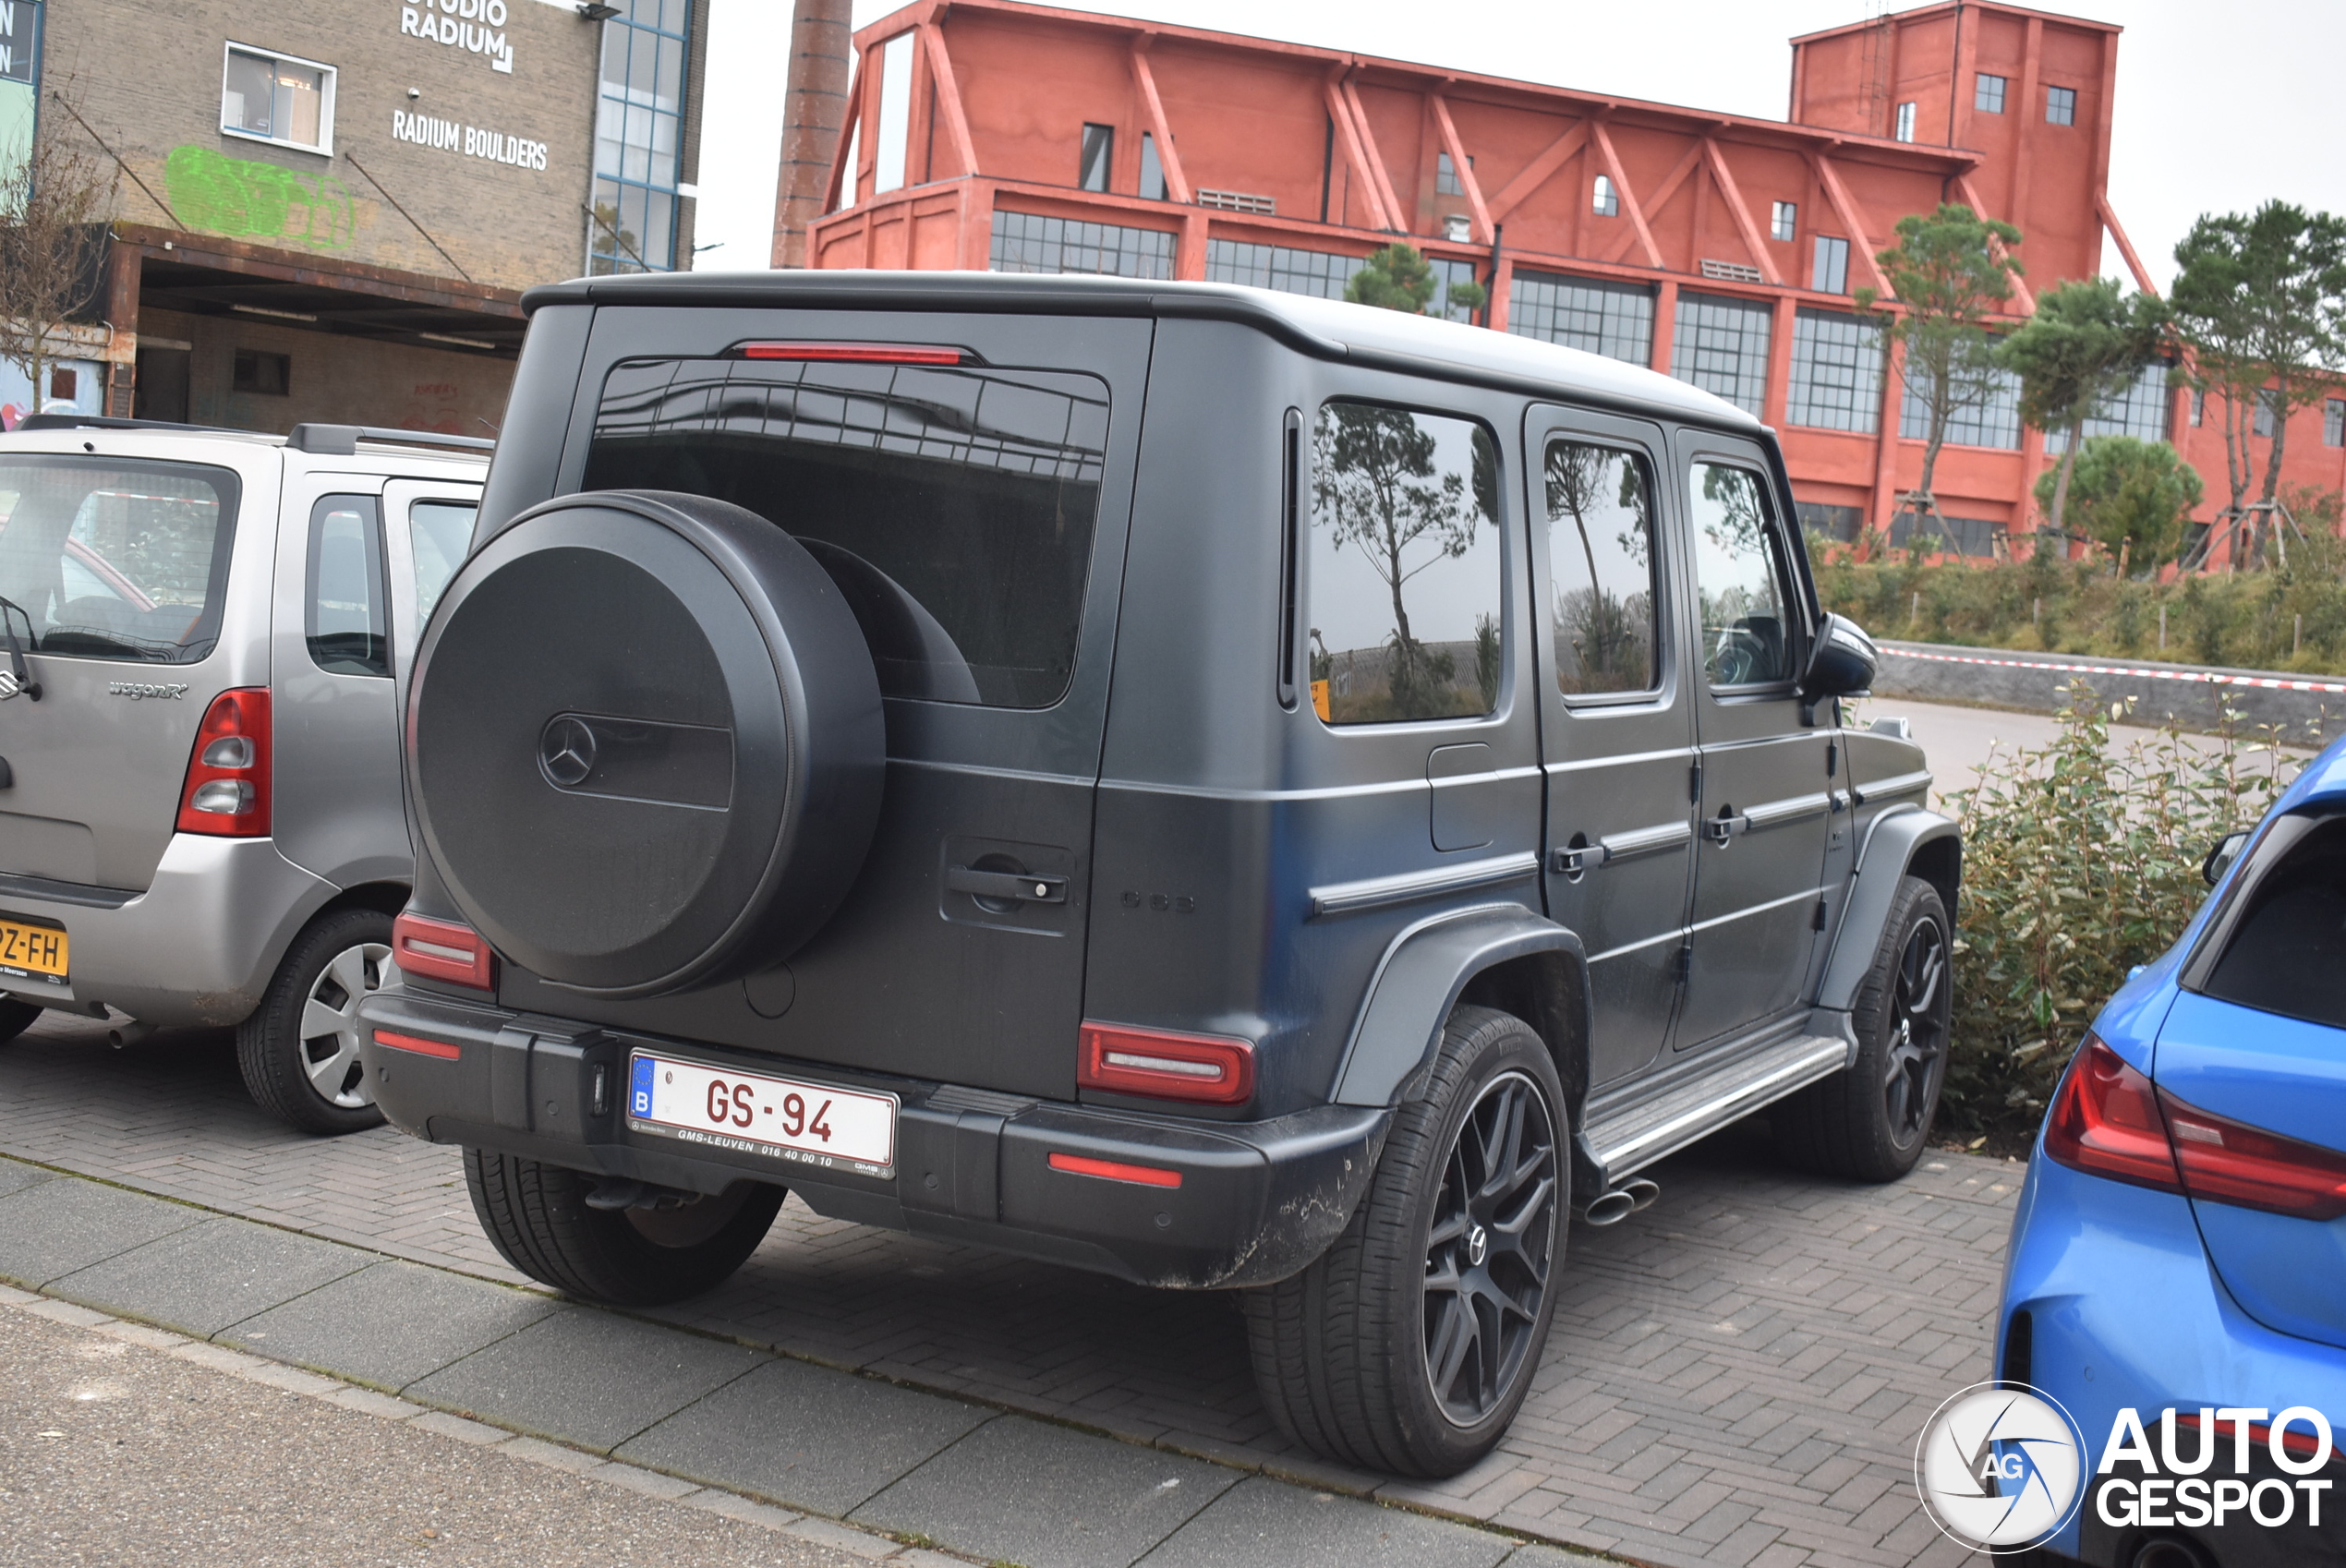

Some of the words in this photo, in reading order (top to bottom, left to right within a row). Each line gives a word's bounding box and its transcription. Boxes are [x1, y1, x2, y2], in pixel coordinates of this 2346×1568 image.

[401, 6, 505, 58] RADIUM
[405, 0, 507, 27] UDIO
[393, 110, 459, 152] RADIUM
[465, 126, 547, 171] BOULDERS
[0, 927, 58, 968] Z-FH
[635, 1091, 648, 1112] B
[707, 1080, 832, 1142] GS-94
[678, 1129, 754, 1152] GMS-LEUVEN
[761, 1145, 780, 1157] 016
[785, 1150, 798, 1161] 40
[802, 1153, 815, 1164] 00
[820, 1156, 832, 1167] 10
